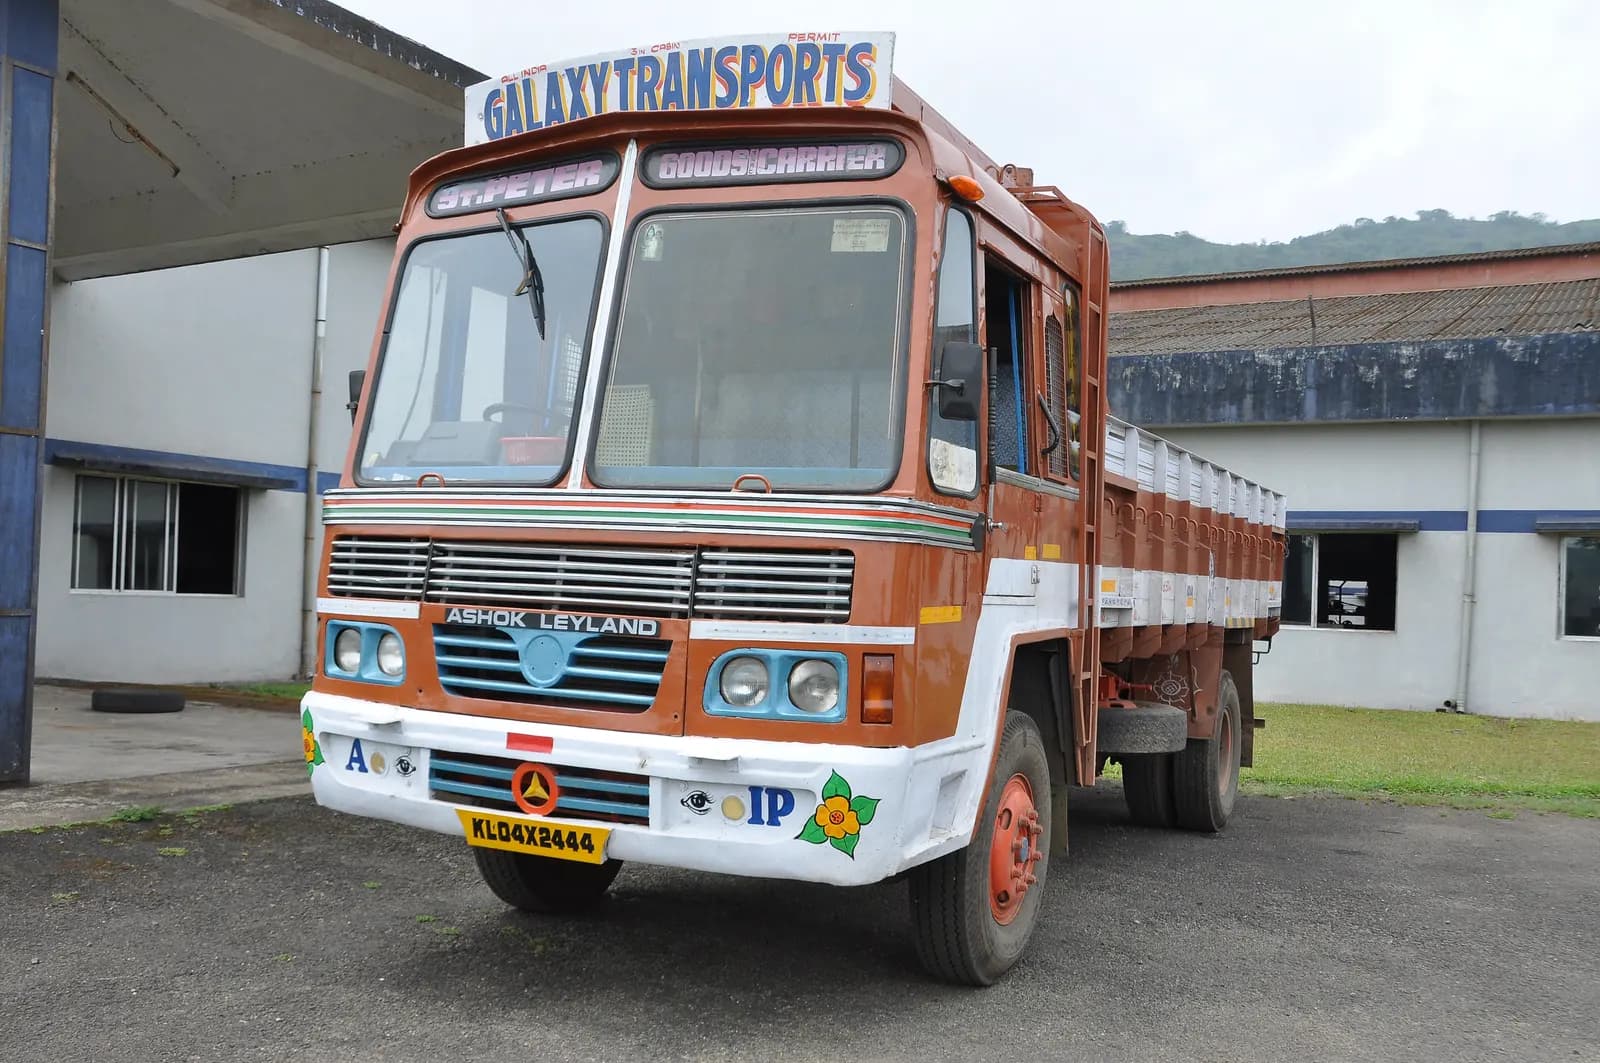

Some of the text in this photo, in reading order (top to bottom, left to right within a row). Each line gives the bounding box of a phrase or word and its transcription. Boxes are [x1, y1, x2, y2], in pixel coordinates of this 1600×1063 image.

[650, 42, 680, 53] CABIN
[788, 32, 840, 42] PERMIT
[501, 64, 548, 83] ALL INDIA
[484, 42, 877, 141] GALAXY TRANSPORTS
[659, 150, 748, 179] GOODS
[757, 145, 887, 175] CARRIER
[446, 608, 657, 636] ASHOK LEYLAND
[345, 738, 368, 773] A
[747, 786, 795, 827] IP
[472, 817, 595, 853] KL04X2444
